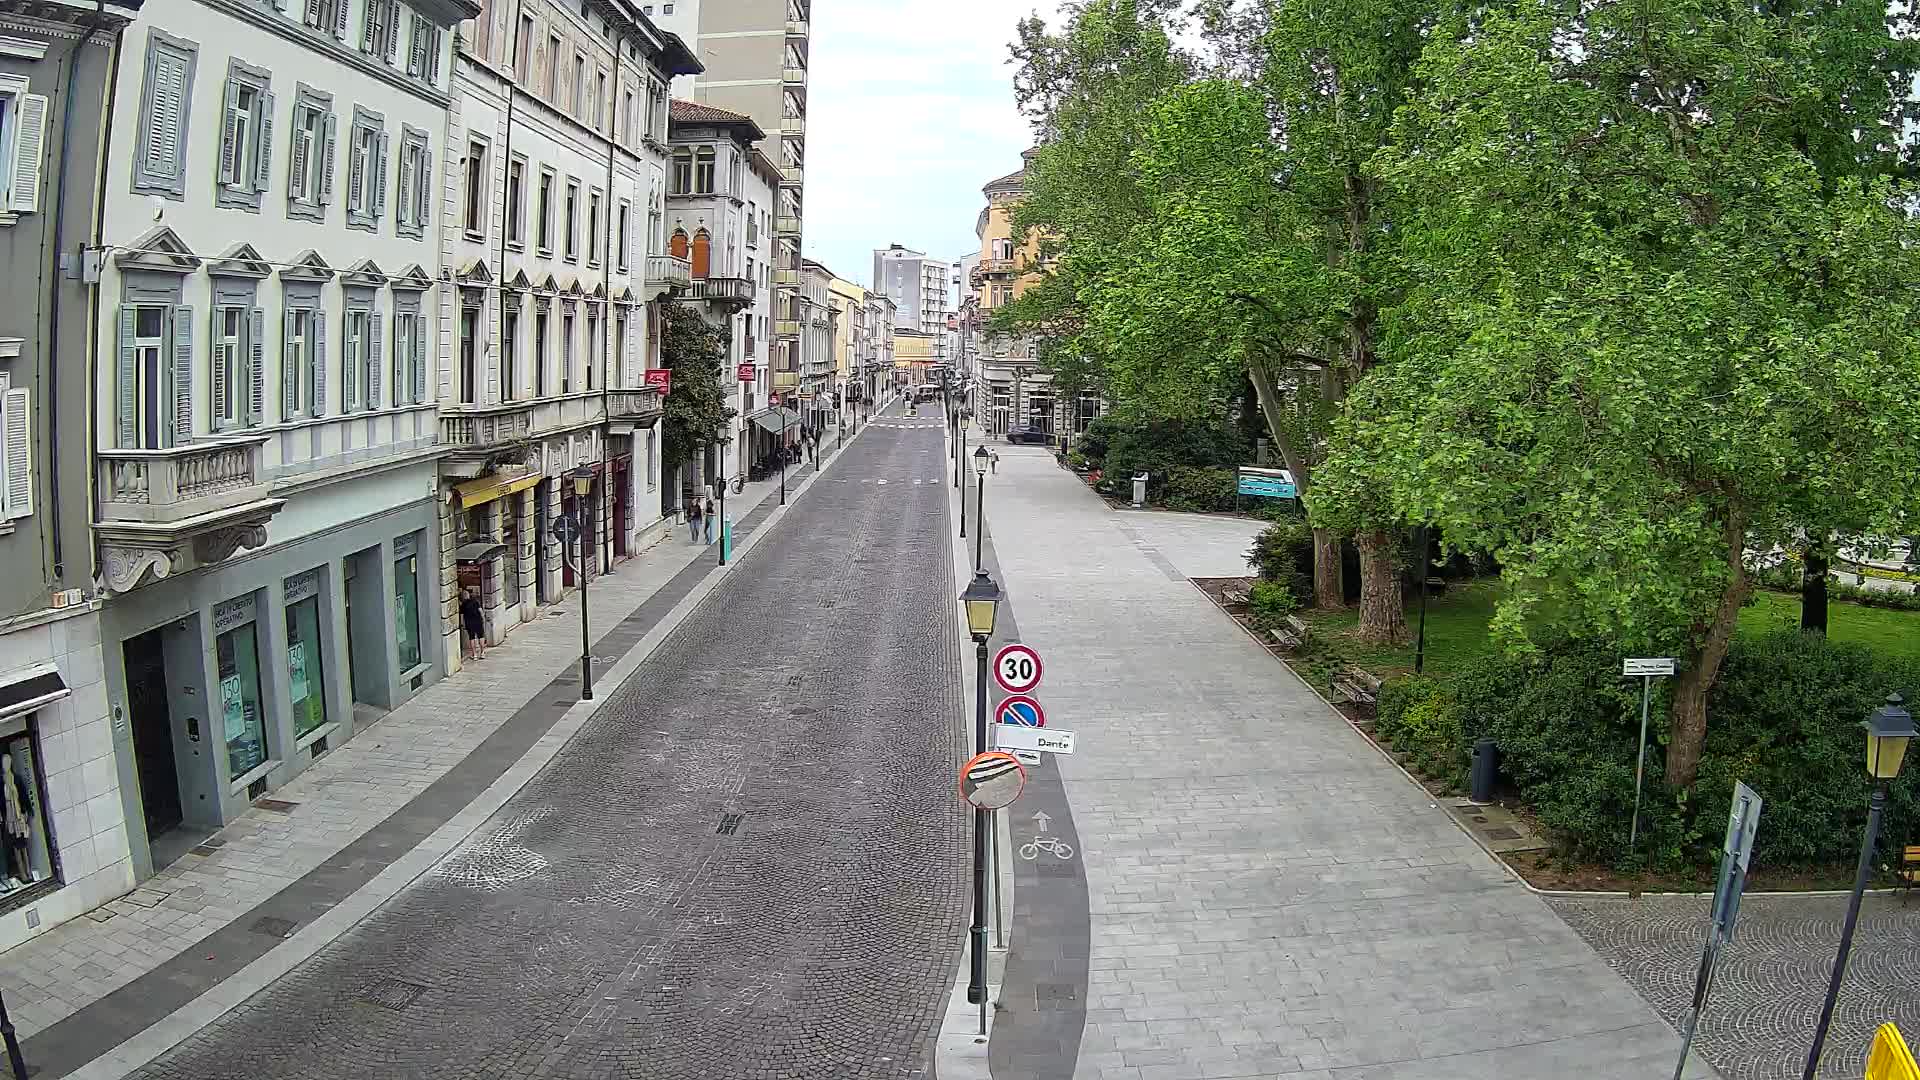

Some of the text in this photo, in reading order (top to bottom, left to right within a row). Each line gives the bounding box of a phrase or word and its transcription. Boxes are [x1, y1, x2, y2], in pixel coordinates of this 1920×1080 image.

[1005, 658, 1032, 680] 30
[222, 677, 240, 703] 130
[1038, 738, 1069, 749] Dante
